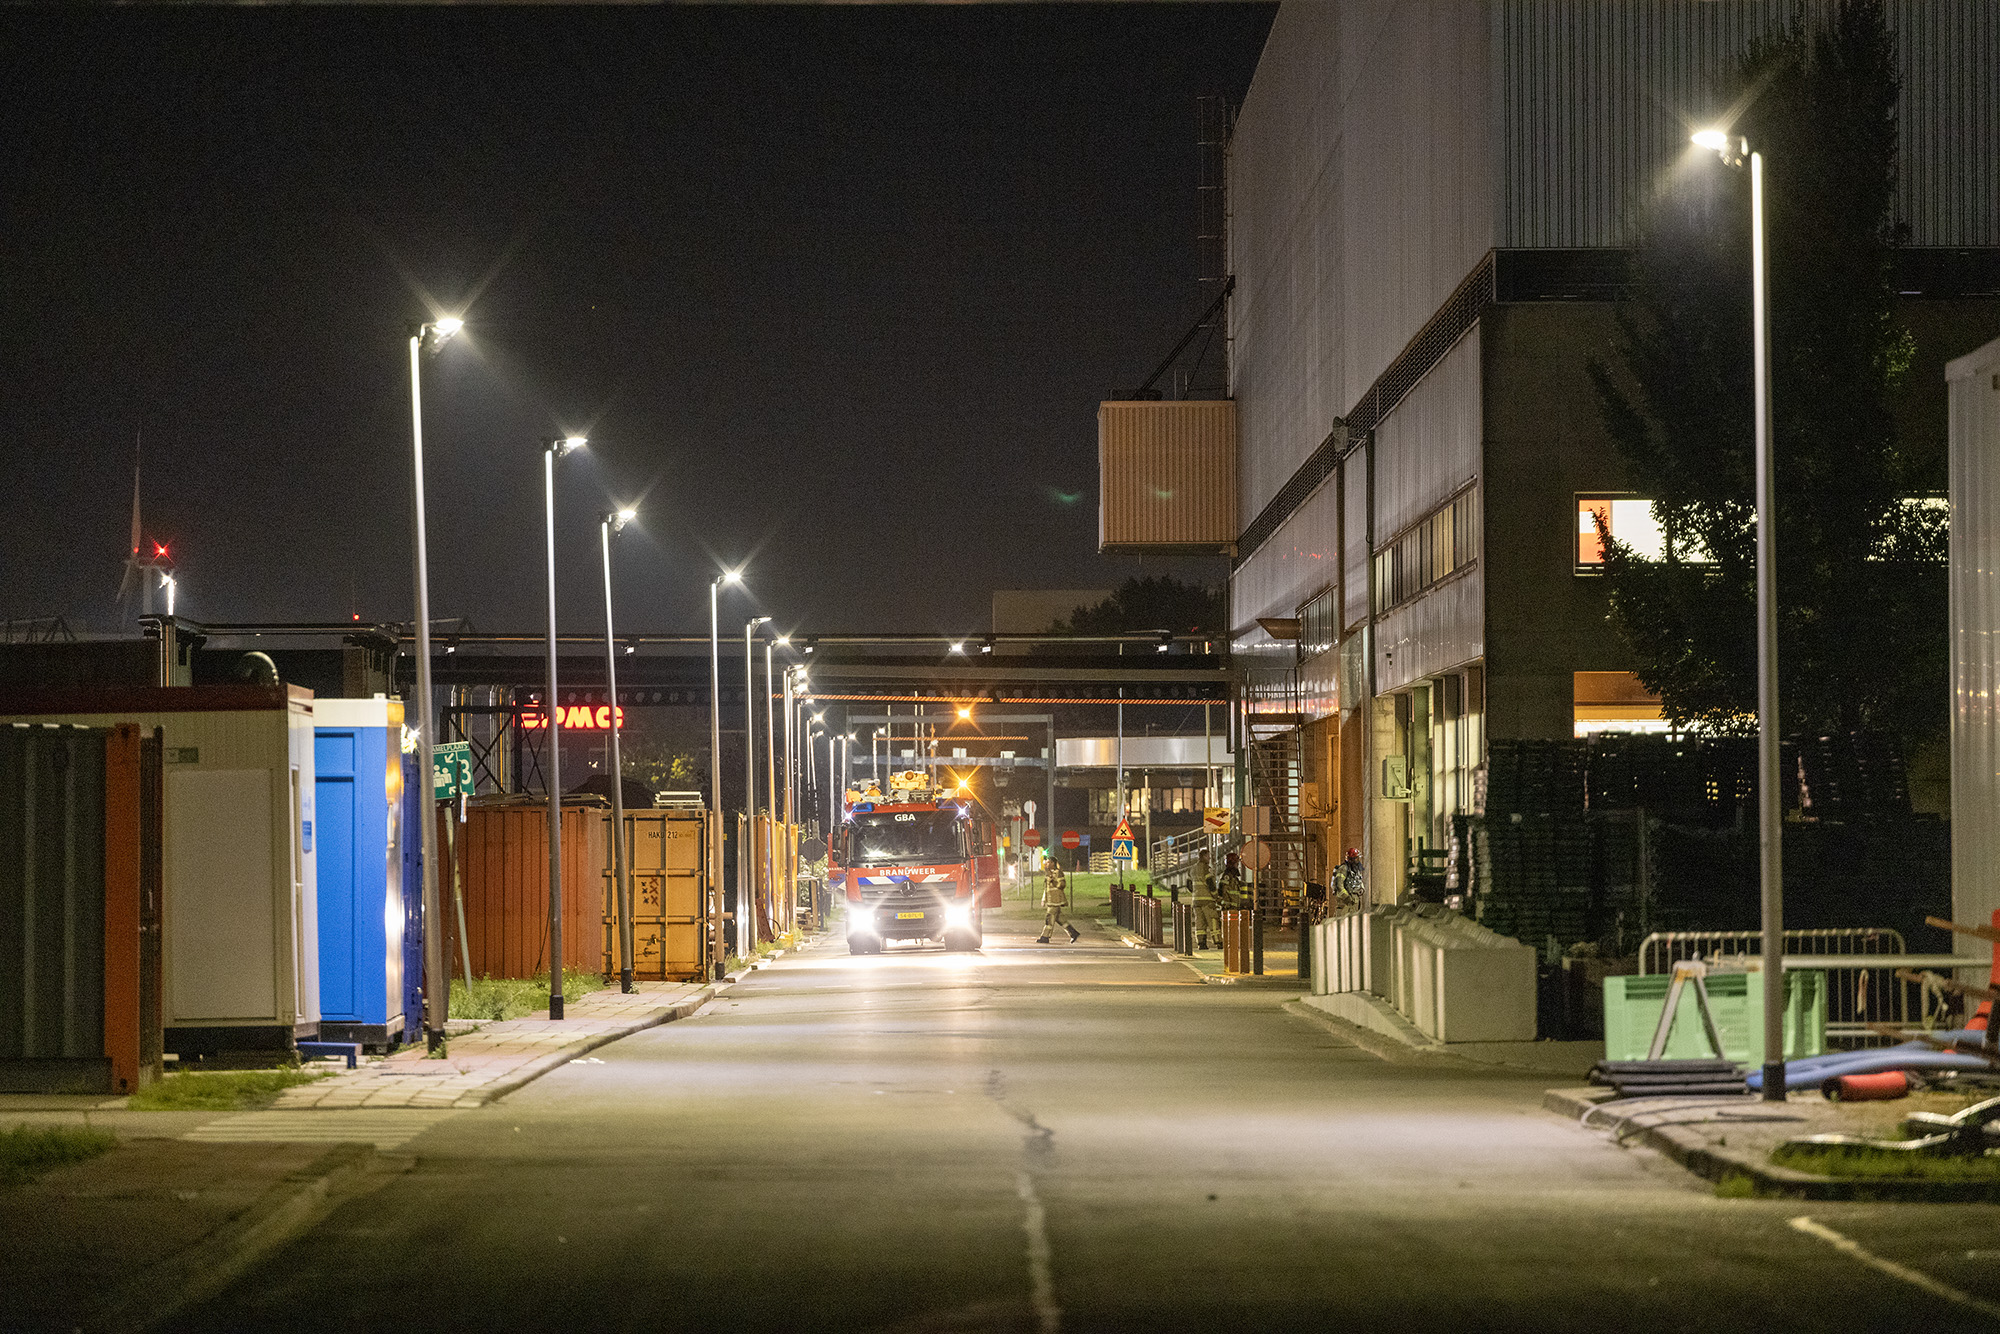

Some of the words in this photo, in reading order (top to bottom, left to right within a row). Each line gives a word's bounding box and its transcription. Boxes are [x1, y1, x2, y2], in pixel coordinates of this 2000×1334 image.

[461, 759, 472, 785] 3
[894, 813, 916, 822] GBA
[667, 831, 678, 839] 212
[879, 867, 936, 876] BRANDWEER
